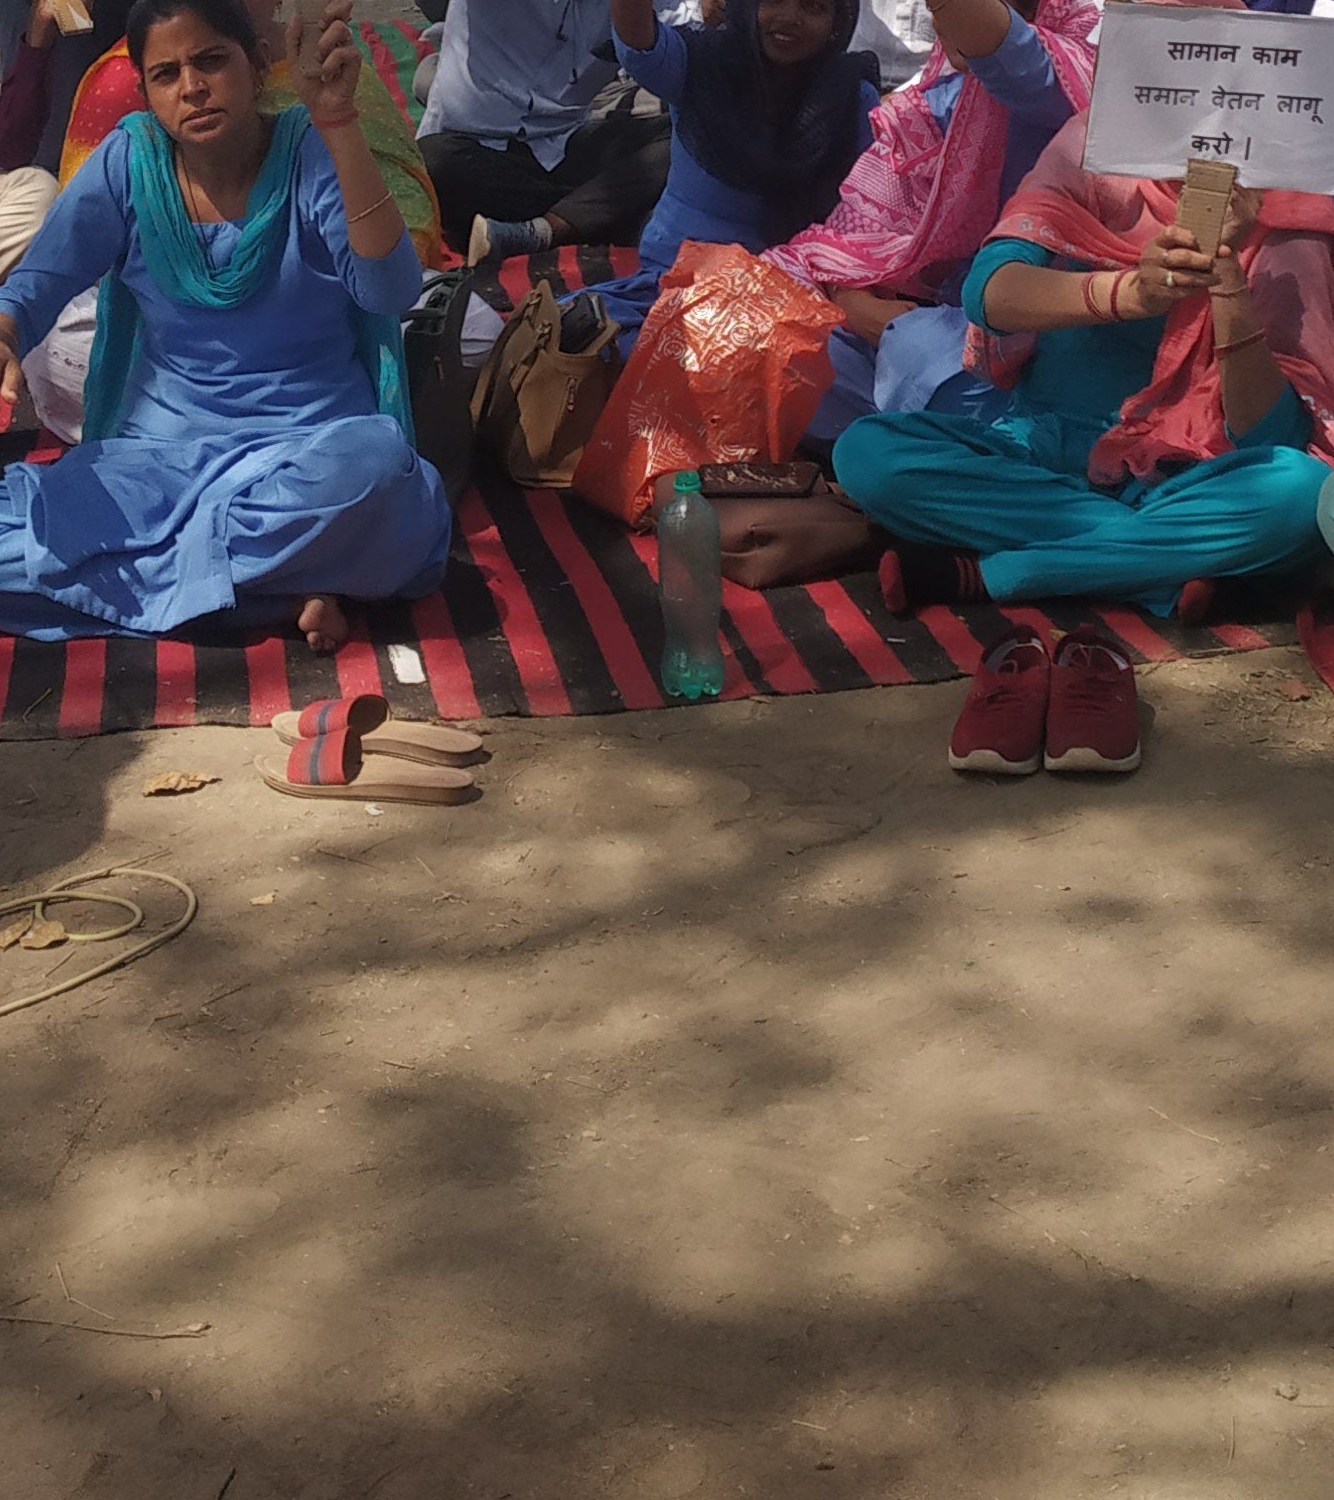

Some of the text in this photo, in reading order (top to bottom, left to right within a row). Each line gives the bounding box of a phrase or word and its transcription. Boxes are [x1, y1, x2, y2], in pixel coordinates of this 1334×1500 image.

[1167, 41, 1302, 67] सामान काम
[1134, 85, 1200, 107] समान
[1211, 84, 1265, 111] वेतन
[1277, 93, 1324, 124] लागू
[1191, 131, 1233, 159] करो
